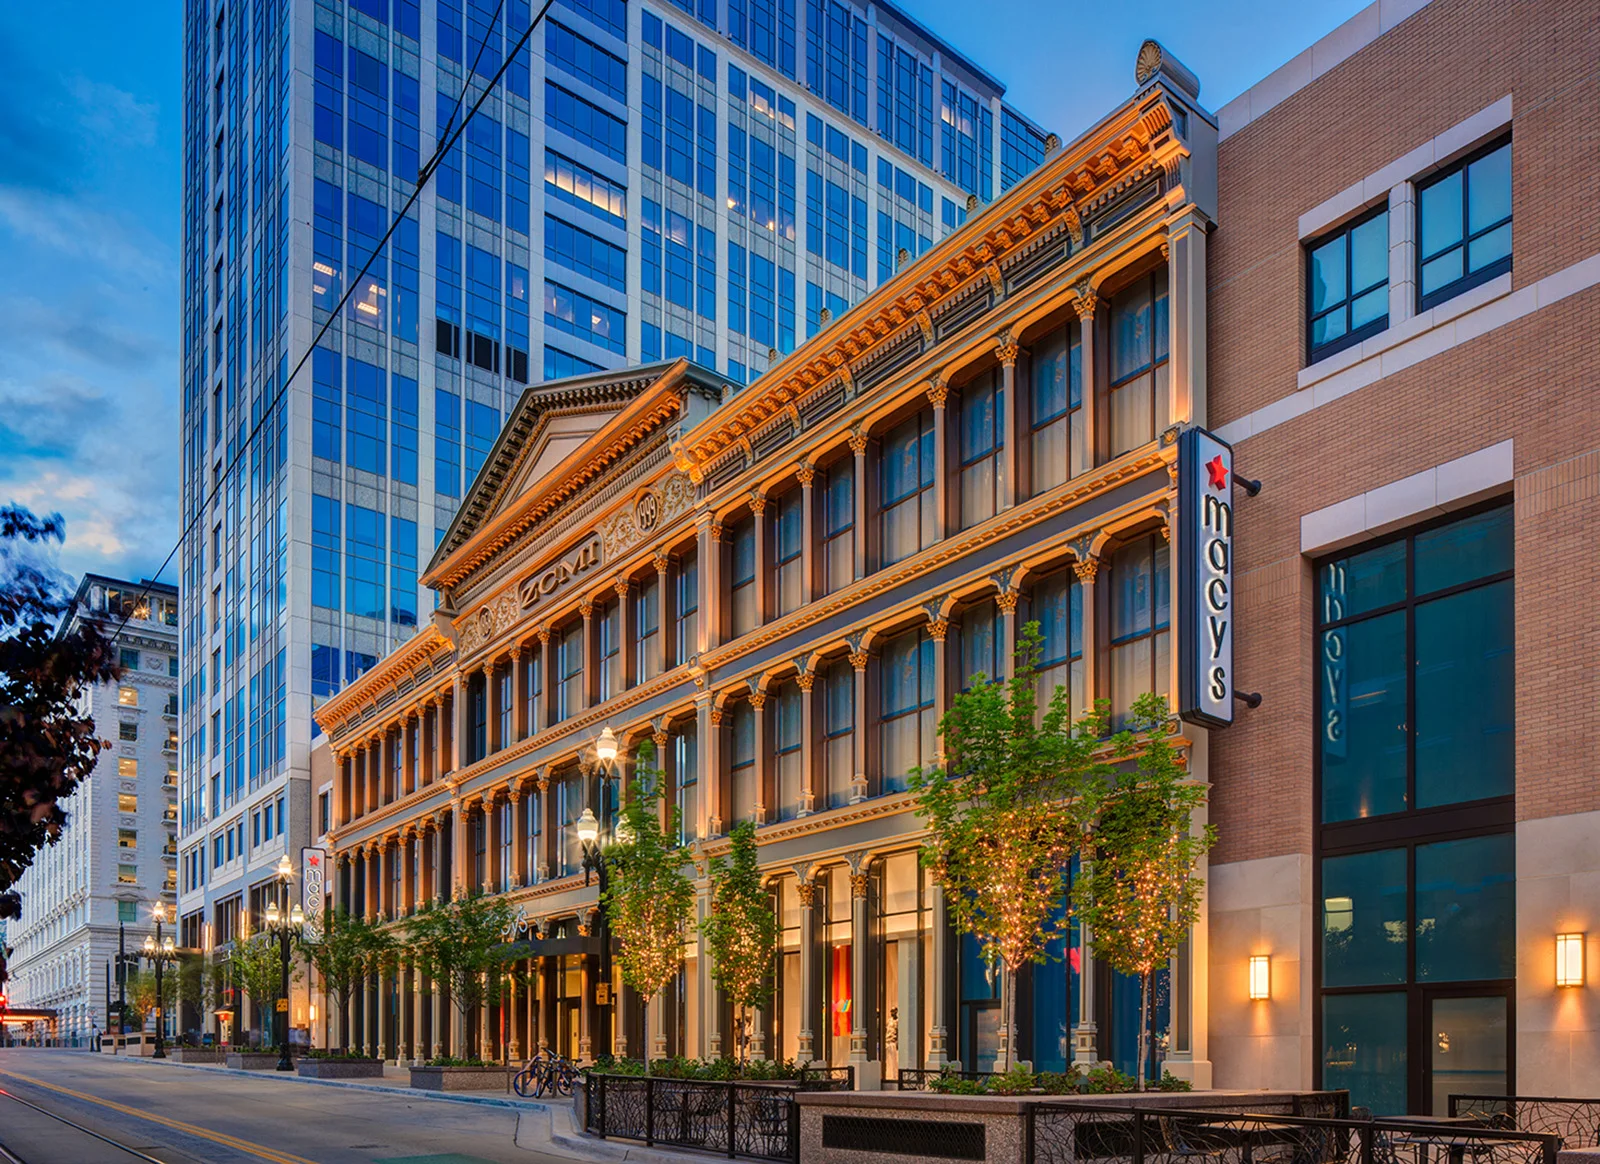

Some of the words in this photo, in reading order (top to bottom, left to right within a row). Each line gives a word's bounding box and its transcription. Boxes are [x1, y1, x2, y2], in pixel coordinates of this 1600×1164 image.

[637, 497, 656, 529] 1999
[521, 540, 599, 610] ZCMI
[1204, 493, 1232, 701] macys
